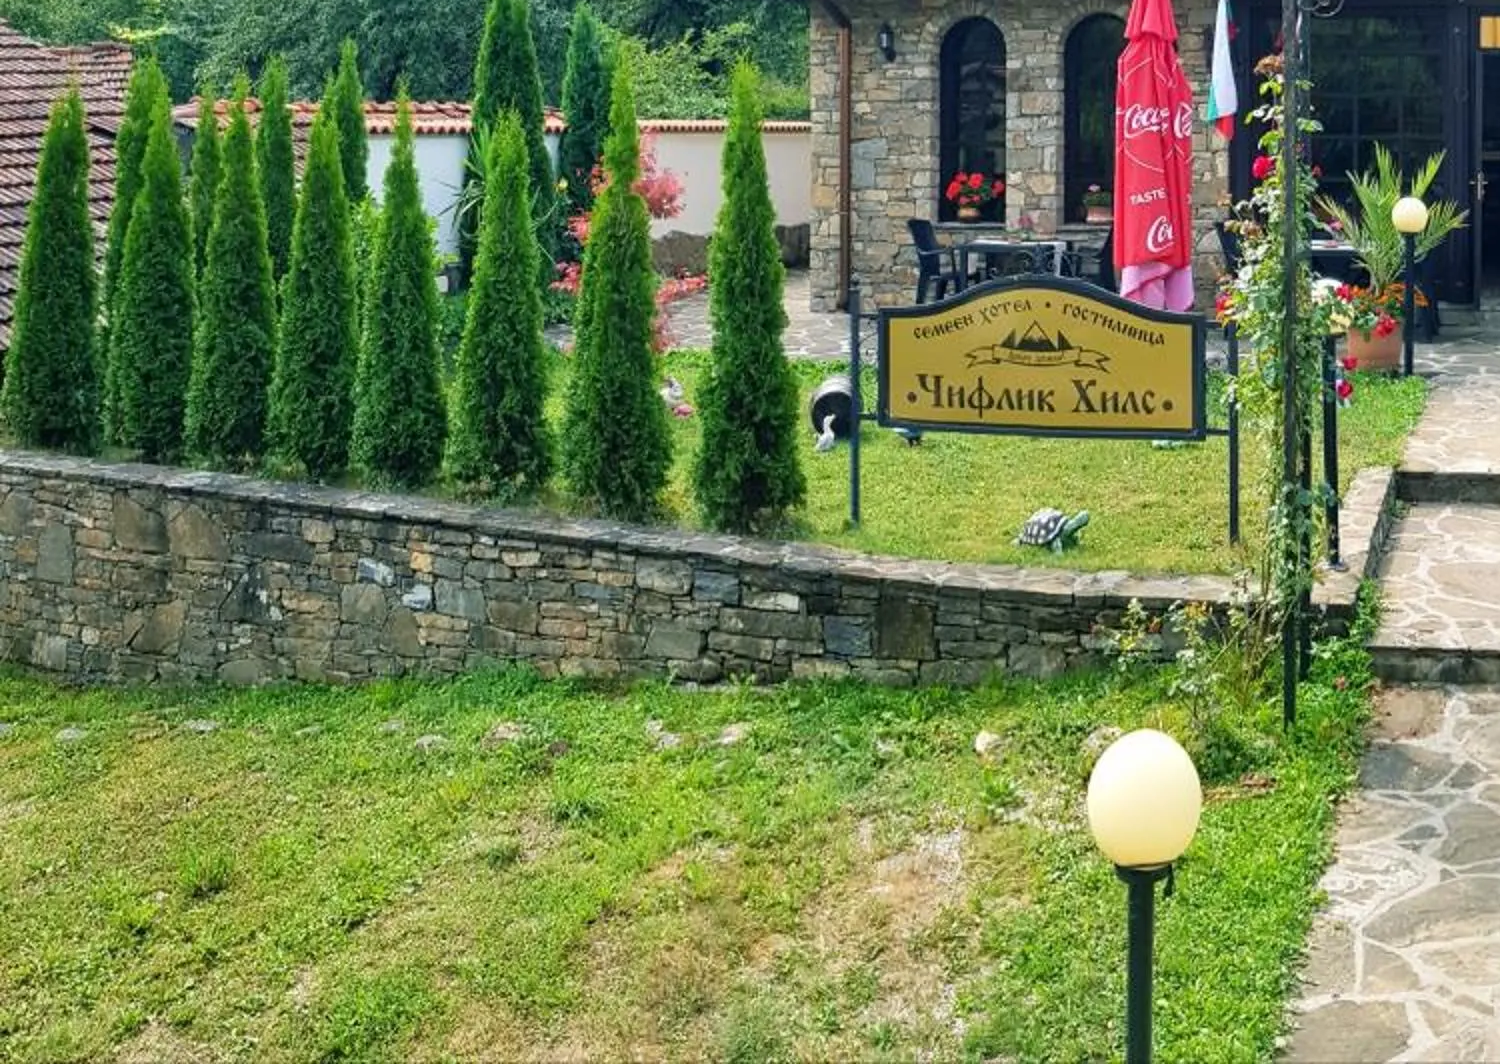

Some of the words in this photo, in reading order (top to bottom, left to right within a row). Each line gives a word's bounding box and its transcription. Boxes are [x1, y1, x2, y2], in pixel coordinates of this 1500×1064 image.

[1130, 187, 1166, 206] TASTE
[916, 373, 1056, 419] Чифлик
[1071, 379, 1157, 415] Хилс
